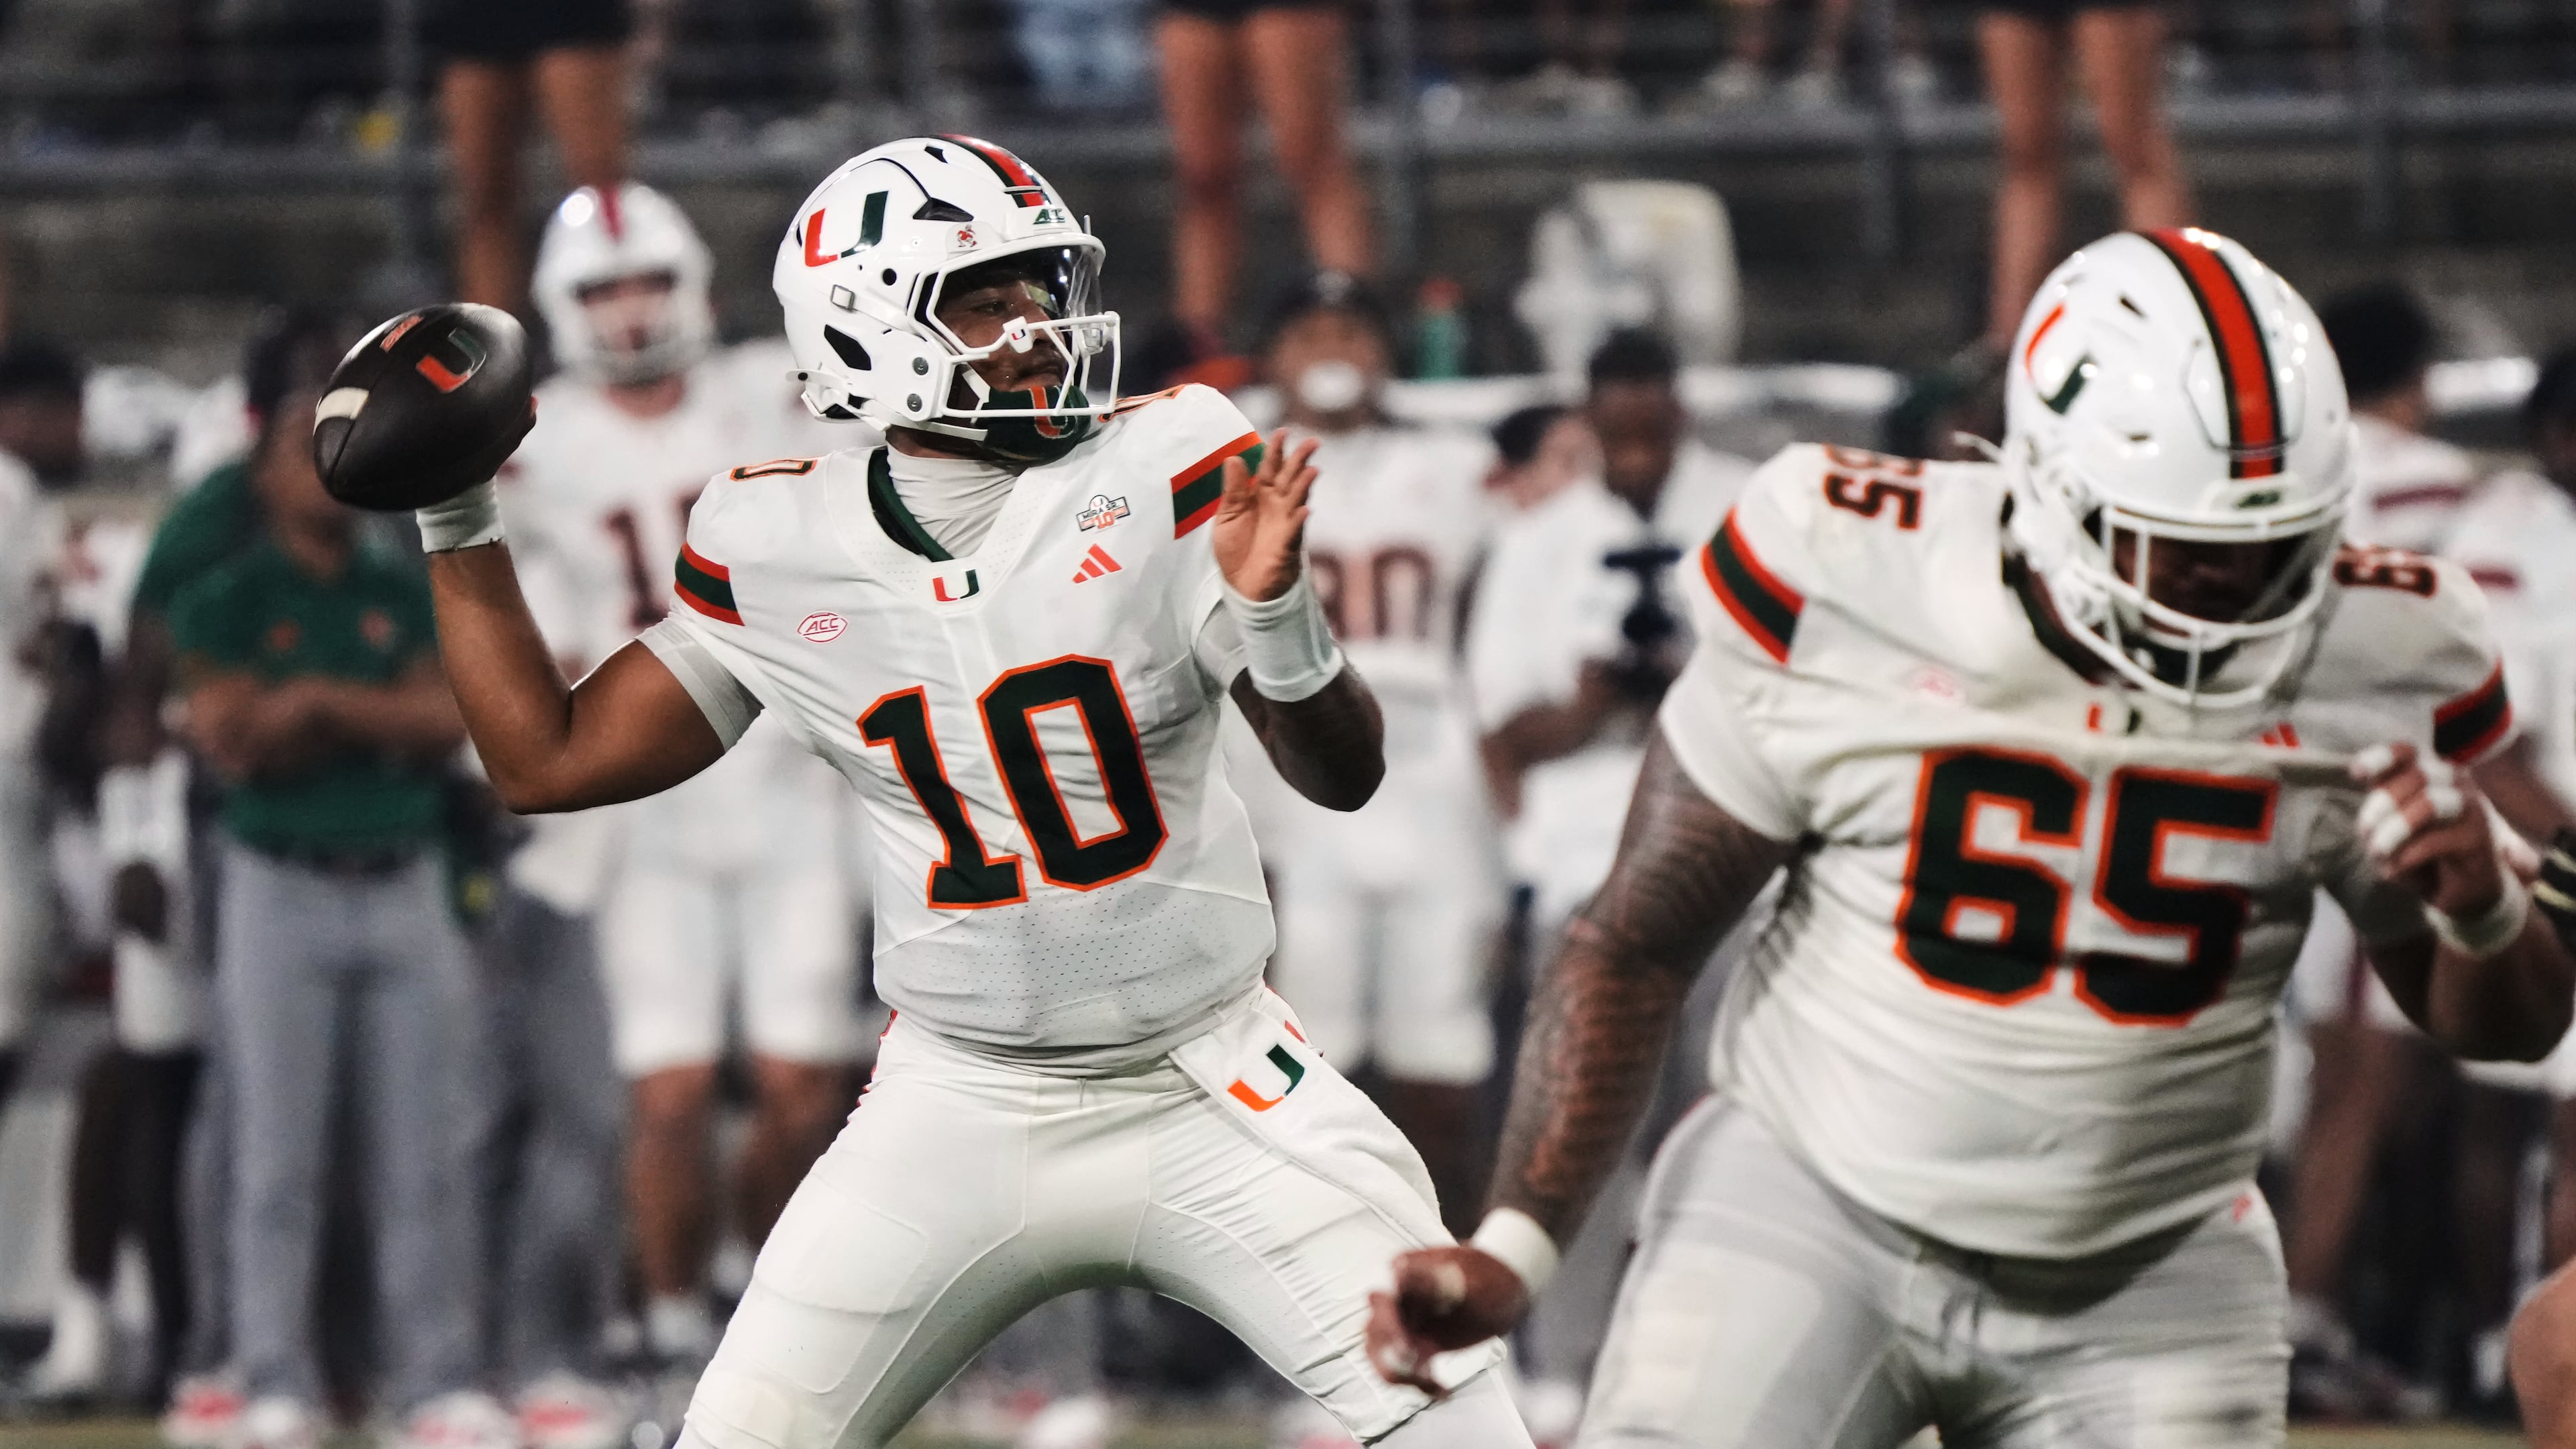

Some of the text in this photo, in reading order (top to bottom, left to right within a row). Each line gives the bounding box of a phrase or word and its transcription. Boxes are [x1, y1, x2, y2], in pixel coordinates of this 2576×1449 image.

[805, 191, 888, 267] U
[415, 328, 487, 393] U
[1012, 329, 1026, 340] U
[1095, 512, 1115, 529] 10
[932, 568, 980, 602] U
[805, 617, 839, 633] ACC
[856, 653, 1171, 910] 10
[1894, 745, 2279, 1028] 65
[1227, 1043, 1305, 1112] U
